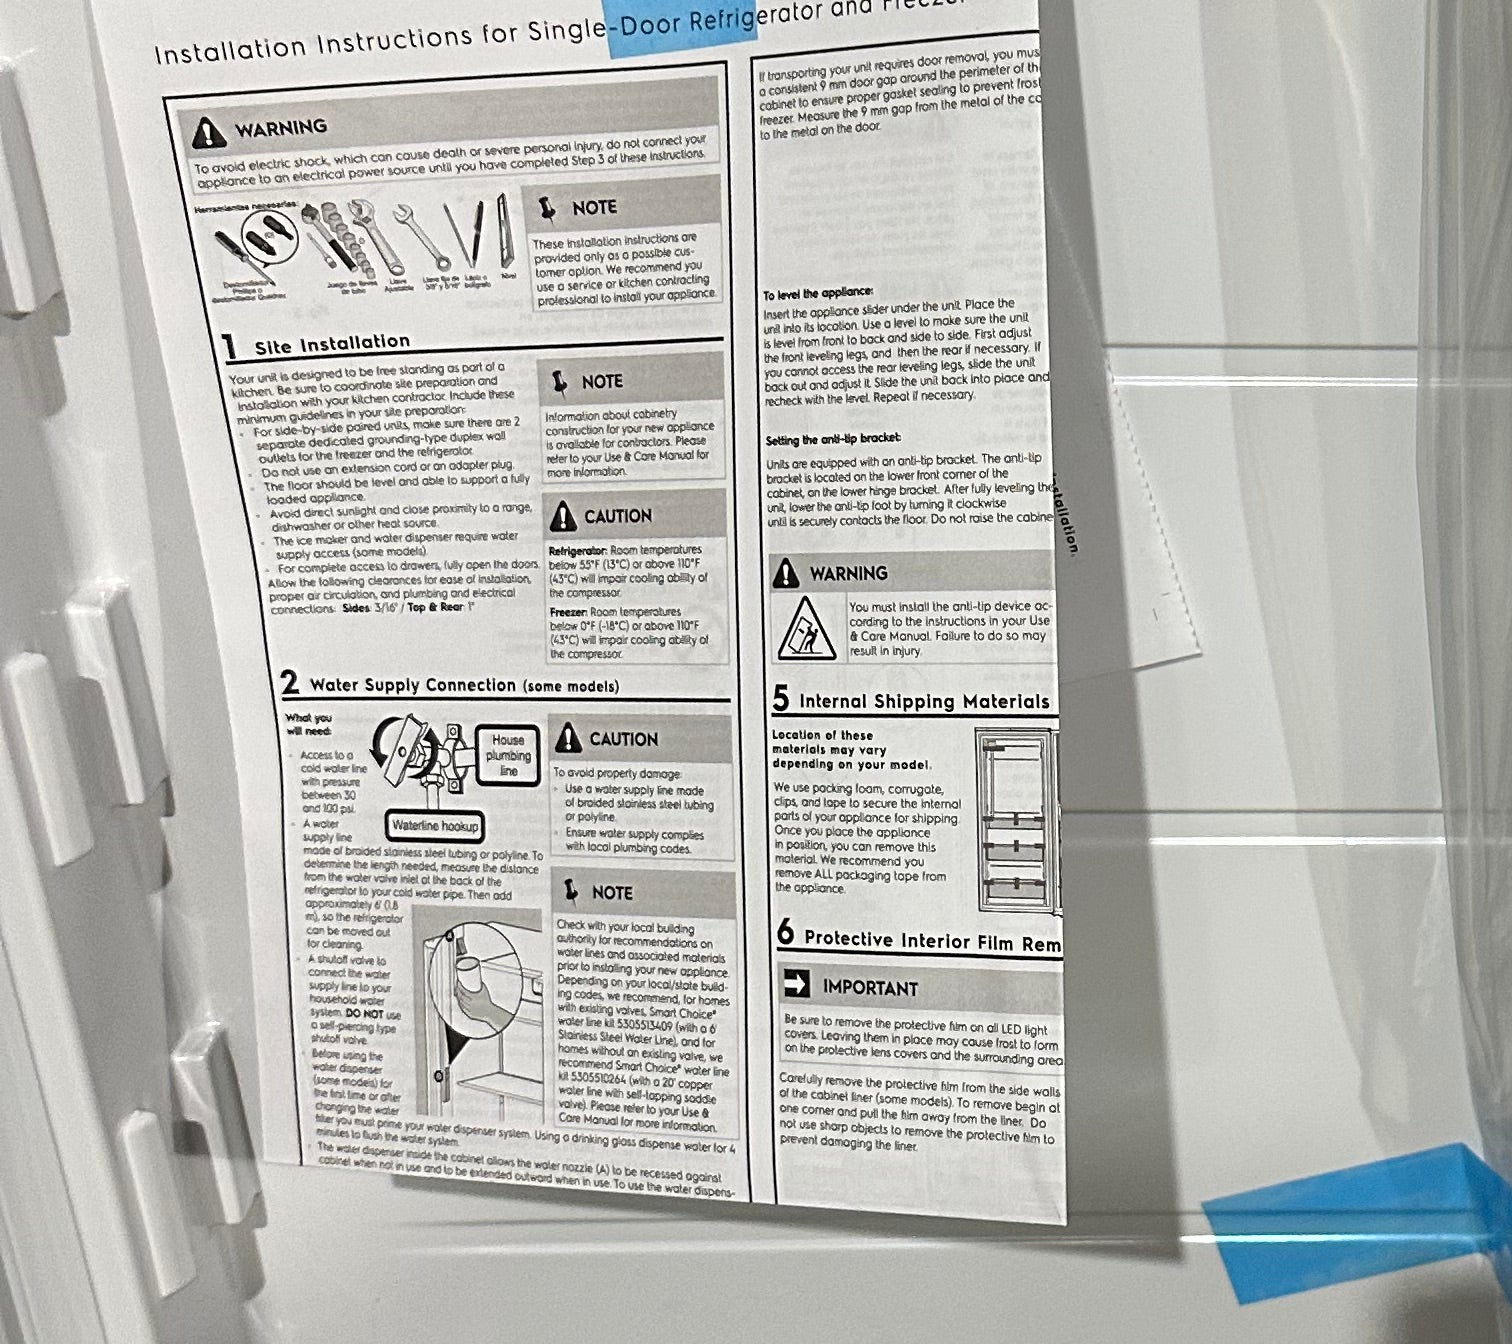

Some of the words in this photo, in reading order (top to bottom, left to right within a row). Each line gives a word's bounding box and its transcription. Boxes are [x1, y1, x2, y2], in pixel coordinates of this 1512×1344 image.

[154, 38, 305, 64] Installation
[317, 28, 472, 53] Instructions
[482, 23, 517, 43] for
[528, 12, 680, 40] Single-Door
[234, 118, 327, 137] WARNING
[572, 199, 617, 215] NOTE
[221, 333, 236, 359] 1
[255, 340, 291, 355] Site
[300, 333, 409, 352] Installation
[582, 373, 623, 389] NOTE
[584, 508, 651, 523] CAUTION
[809, 565, 887, 581] WARNING
[280, 668, 299, 694] 2
[309, 678, 358, 691] Water
[365, 677, 419, 695] Supply
[426, 677, 515, 691] Connection
[522, 678, 561, 693] (some
[567, 679, 619, 694] models)
[772, 683, 789, 711] 5
[800, 693, 866, 708] Internal
[874, 693, 954, 712] Shipping
[963, 693, 1049, 708] Materials
[590, 731, 658, 746] CAUTION
[772, 729, 820, 739] Location
[825, 729, 836, 740] of
[841, 729, 873, 740] these
[772, 743, 825, 754] materials
[830, 746, 854, 757] may
[859, 747, 886, 757] vary
[772, 757, 833, 771] depending
[838, 761, 852, 769] on
[857, 761, 885, 771] your
[890, 759, 932, 769] model.
[592, 885, 632, 900] NOTE
[777, 917, 793, 944] 6
[805, 929, 893, 947] Protective
[901, 932, 970, 948] Interior
[978, 934, 1013, 950] Film
[823, 978, 918, 996] IMPORTANT
